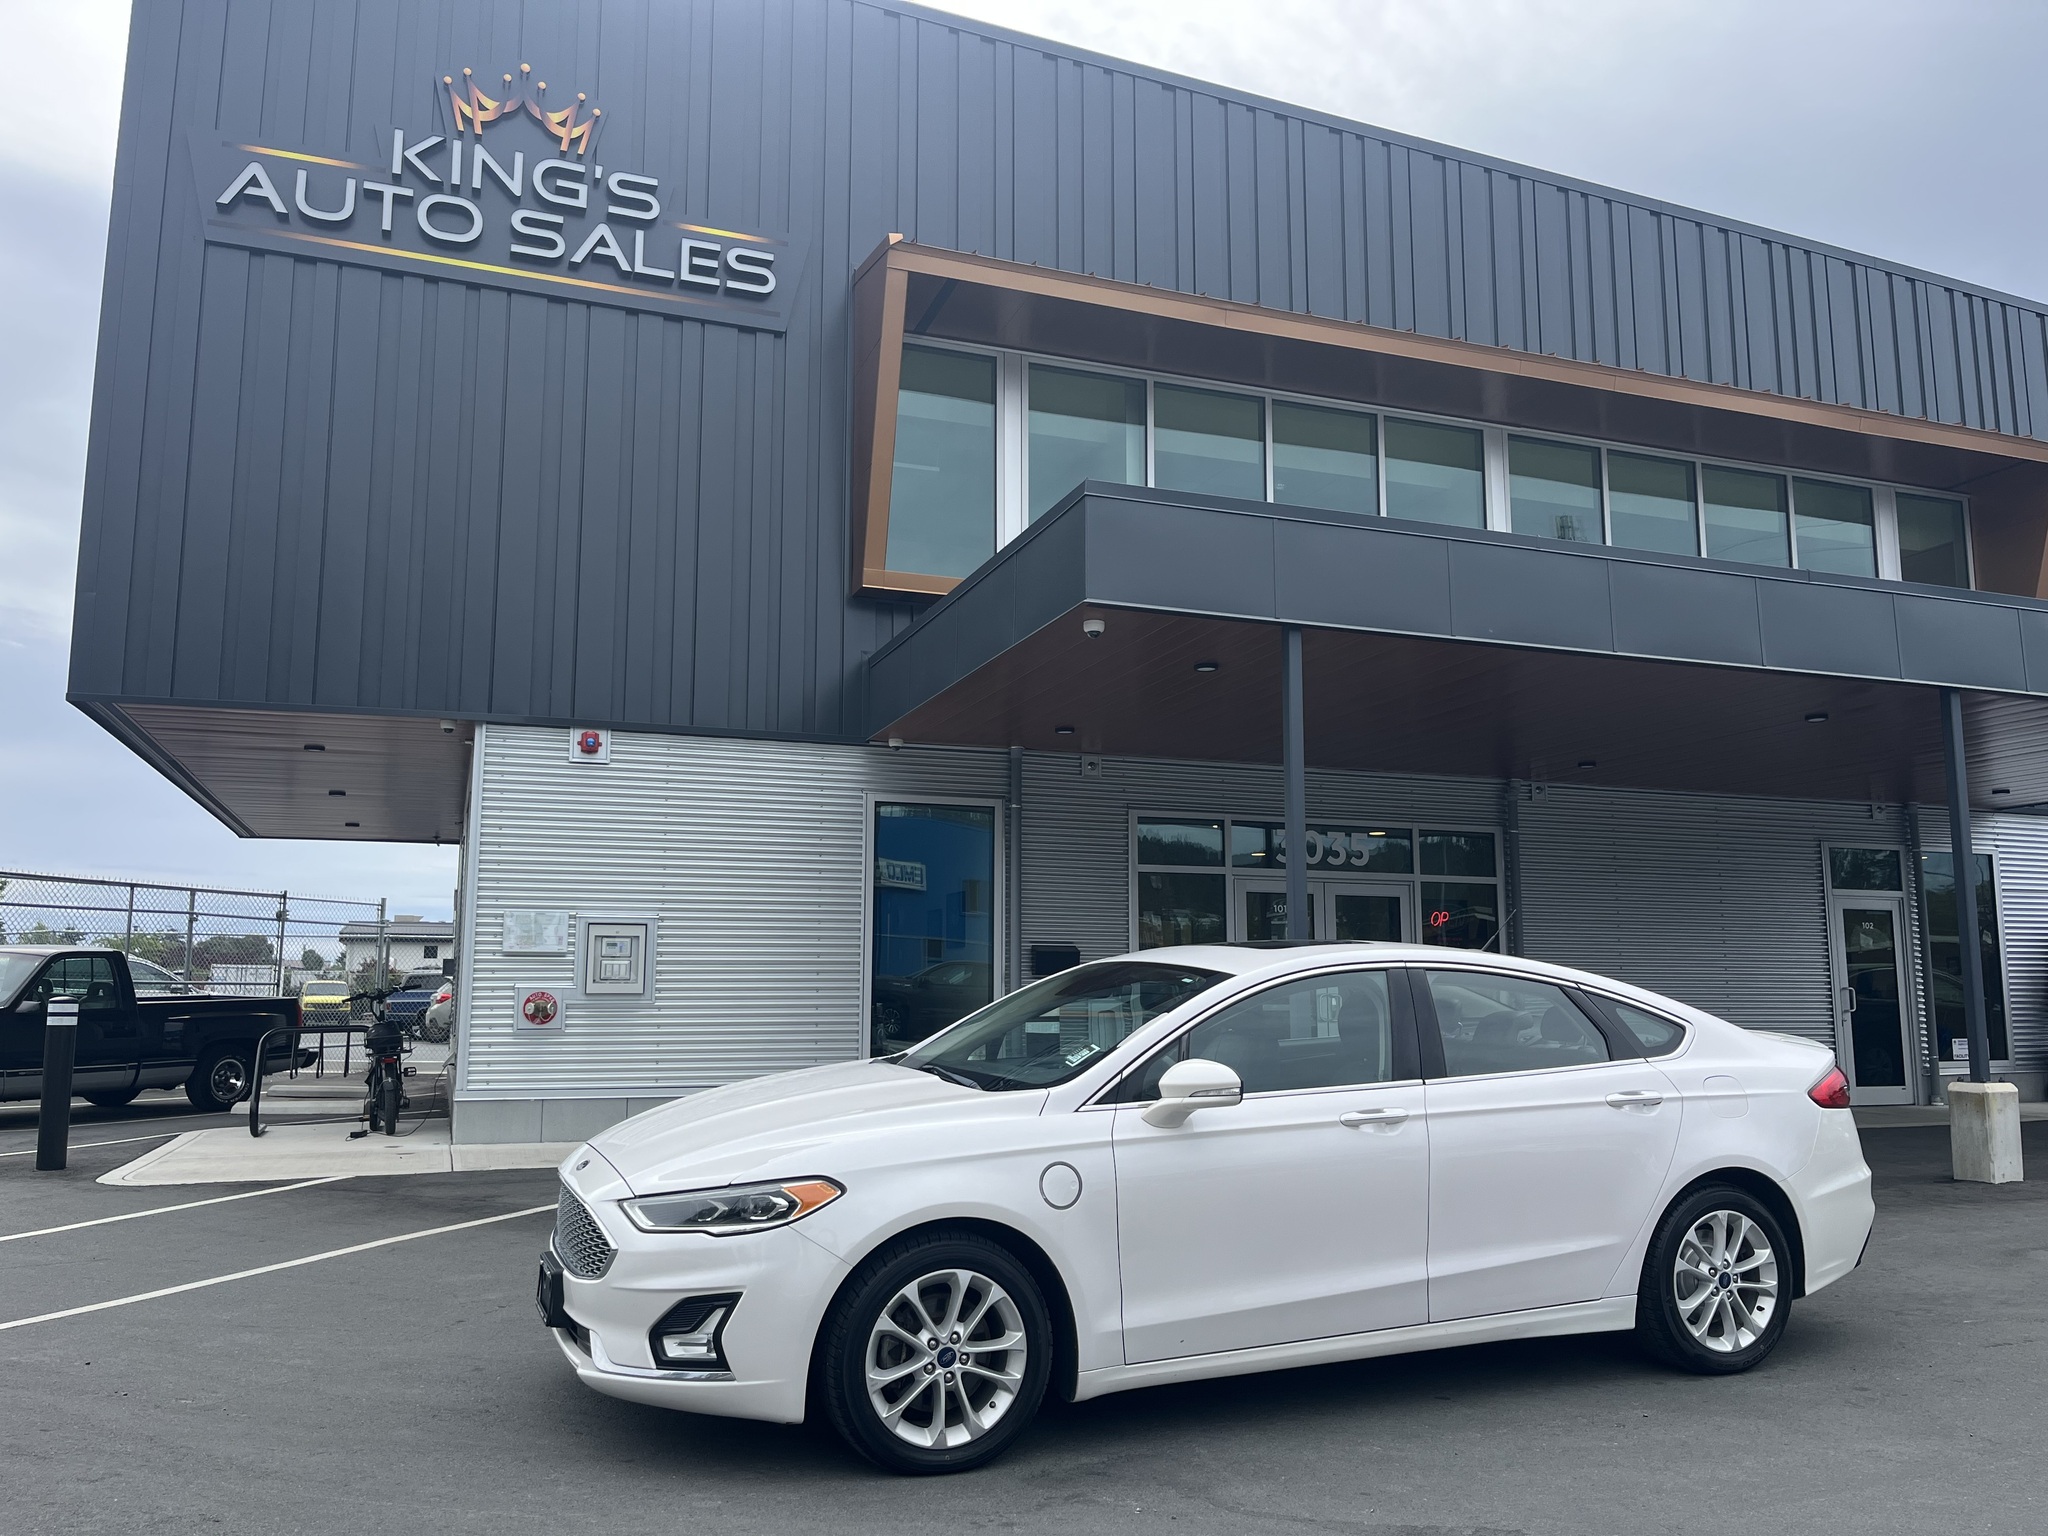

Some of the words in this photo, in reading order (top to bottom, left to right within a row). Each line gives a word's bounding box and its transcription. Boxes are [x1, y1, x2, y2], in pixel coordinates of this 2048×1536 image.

[391, 127, 661, 221] KING'S
[215, 160, 484, 243] AUTO
[510, 208, 777, 294] SALES
[1861, 922, 1874, 930] 102
